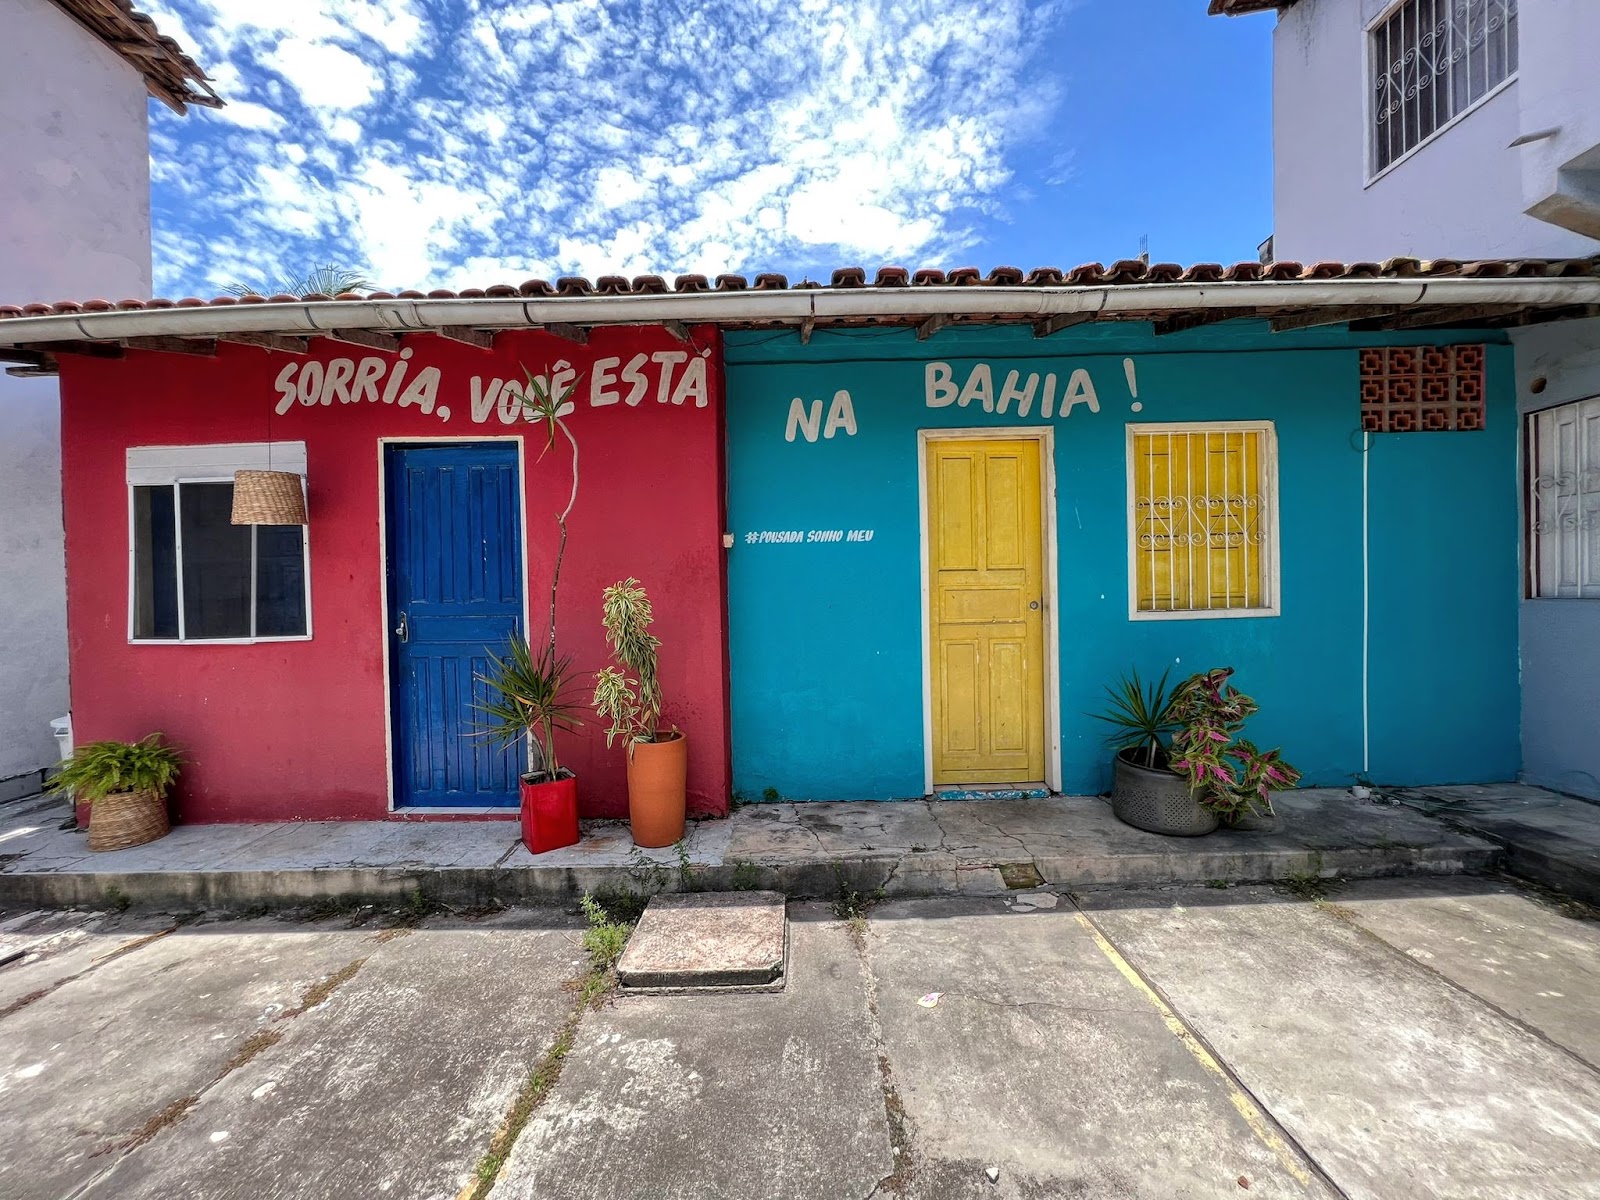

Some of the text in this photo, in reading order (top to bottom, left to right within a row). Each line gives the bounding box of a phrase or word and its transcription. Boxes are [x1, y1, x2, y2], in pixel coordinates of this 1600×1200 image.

[470, 360, 575, 424] VOCÊ
[590, 348, 711, 408] ESTÁ
[785, 390, 858, 442] NA
[925, 361, 1100, 418] BAHIA
[745, 530, 874, 544] #POUSADA SONHO MEU
